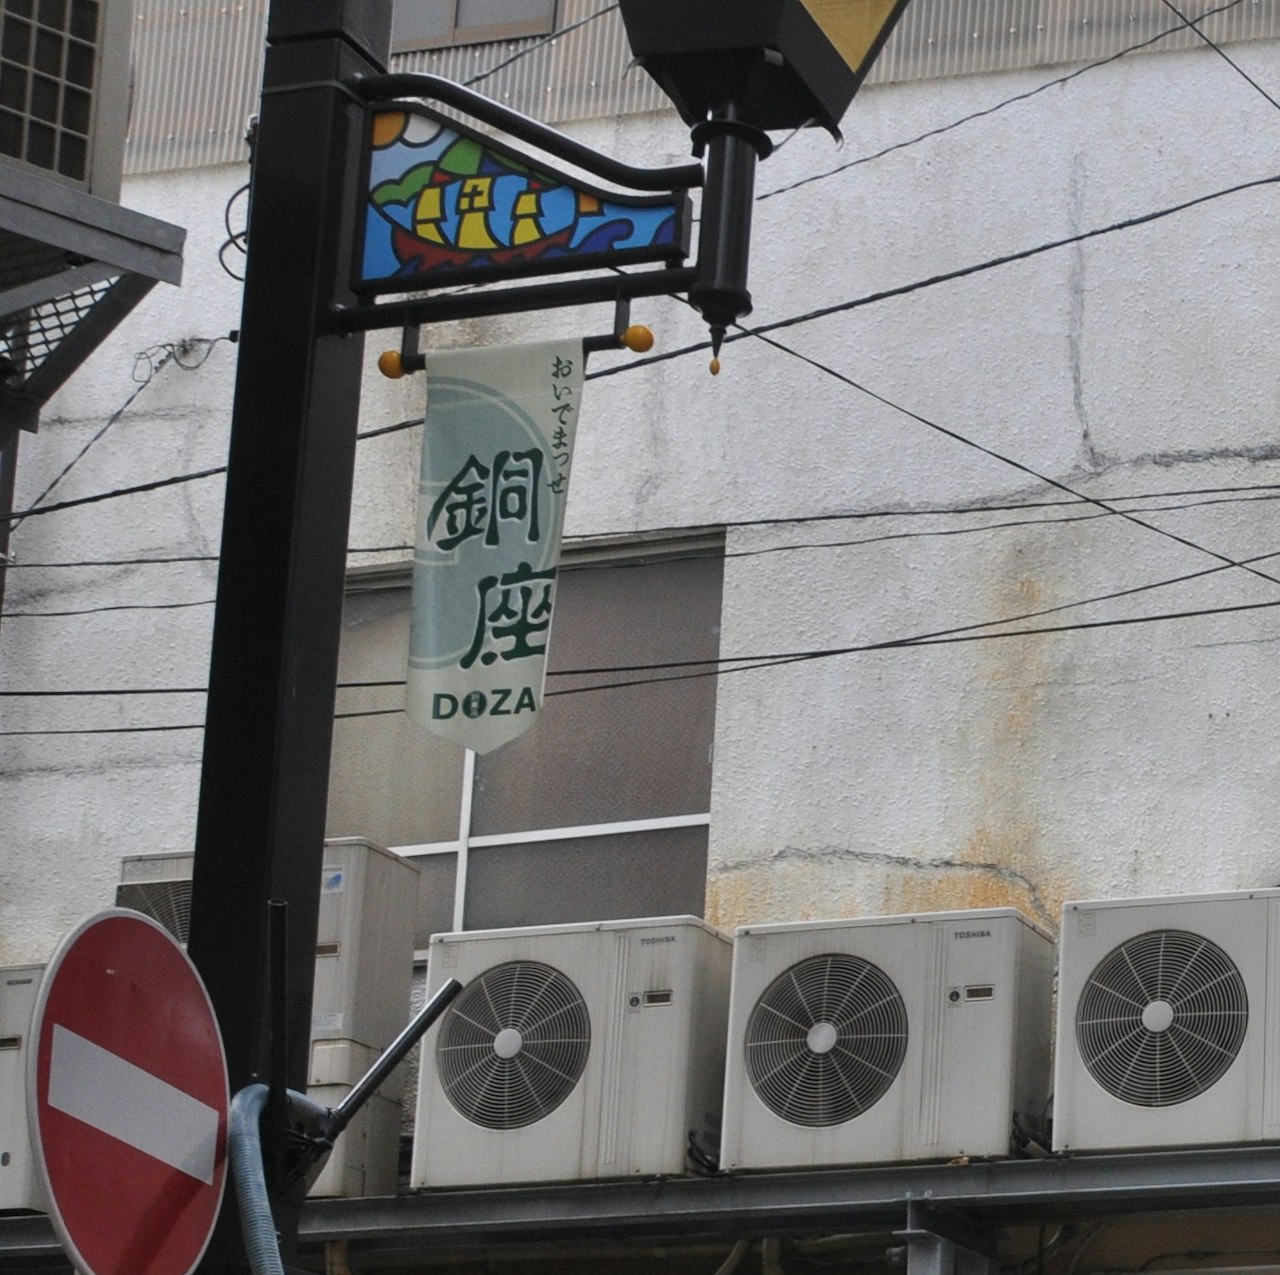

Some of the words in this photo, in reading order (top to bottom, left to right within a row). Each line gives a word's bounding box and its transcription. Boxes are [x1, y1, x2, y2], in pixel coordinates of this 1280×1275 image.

[427, 448, 558, 669] 銅座
[432, 687, 537, 720] DOZA
[640, 935, 676, 946] TOSHIBA
[953, 930, 993, 940] TOSHIBA
